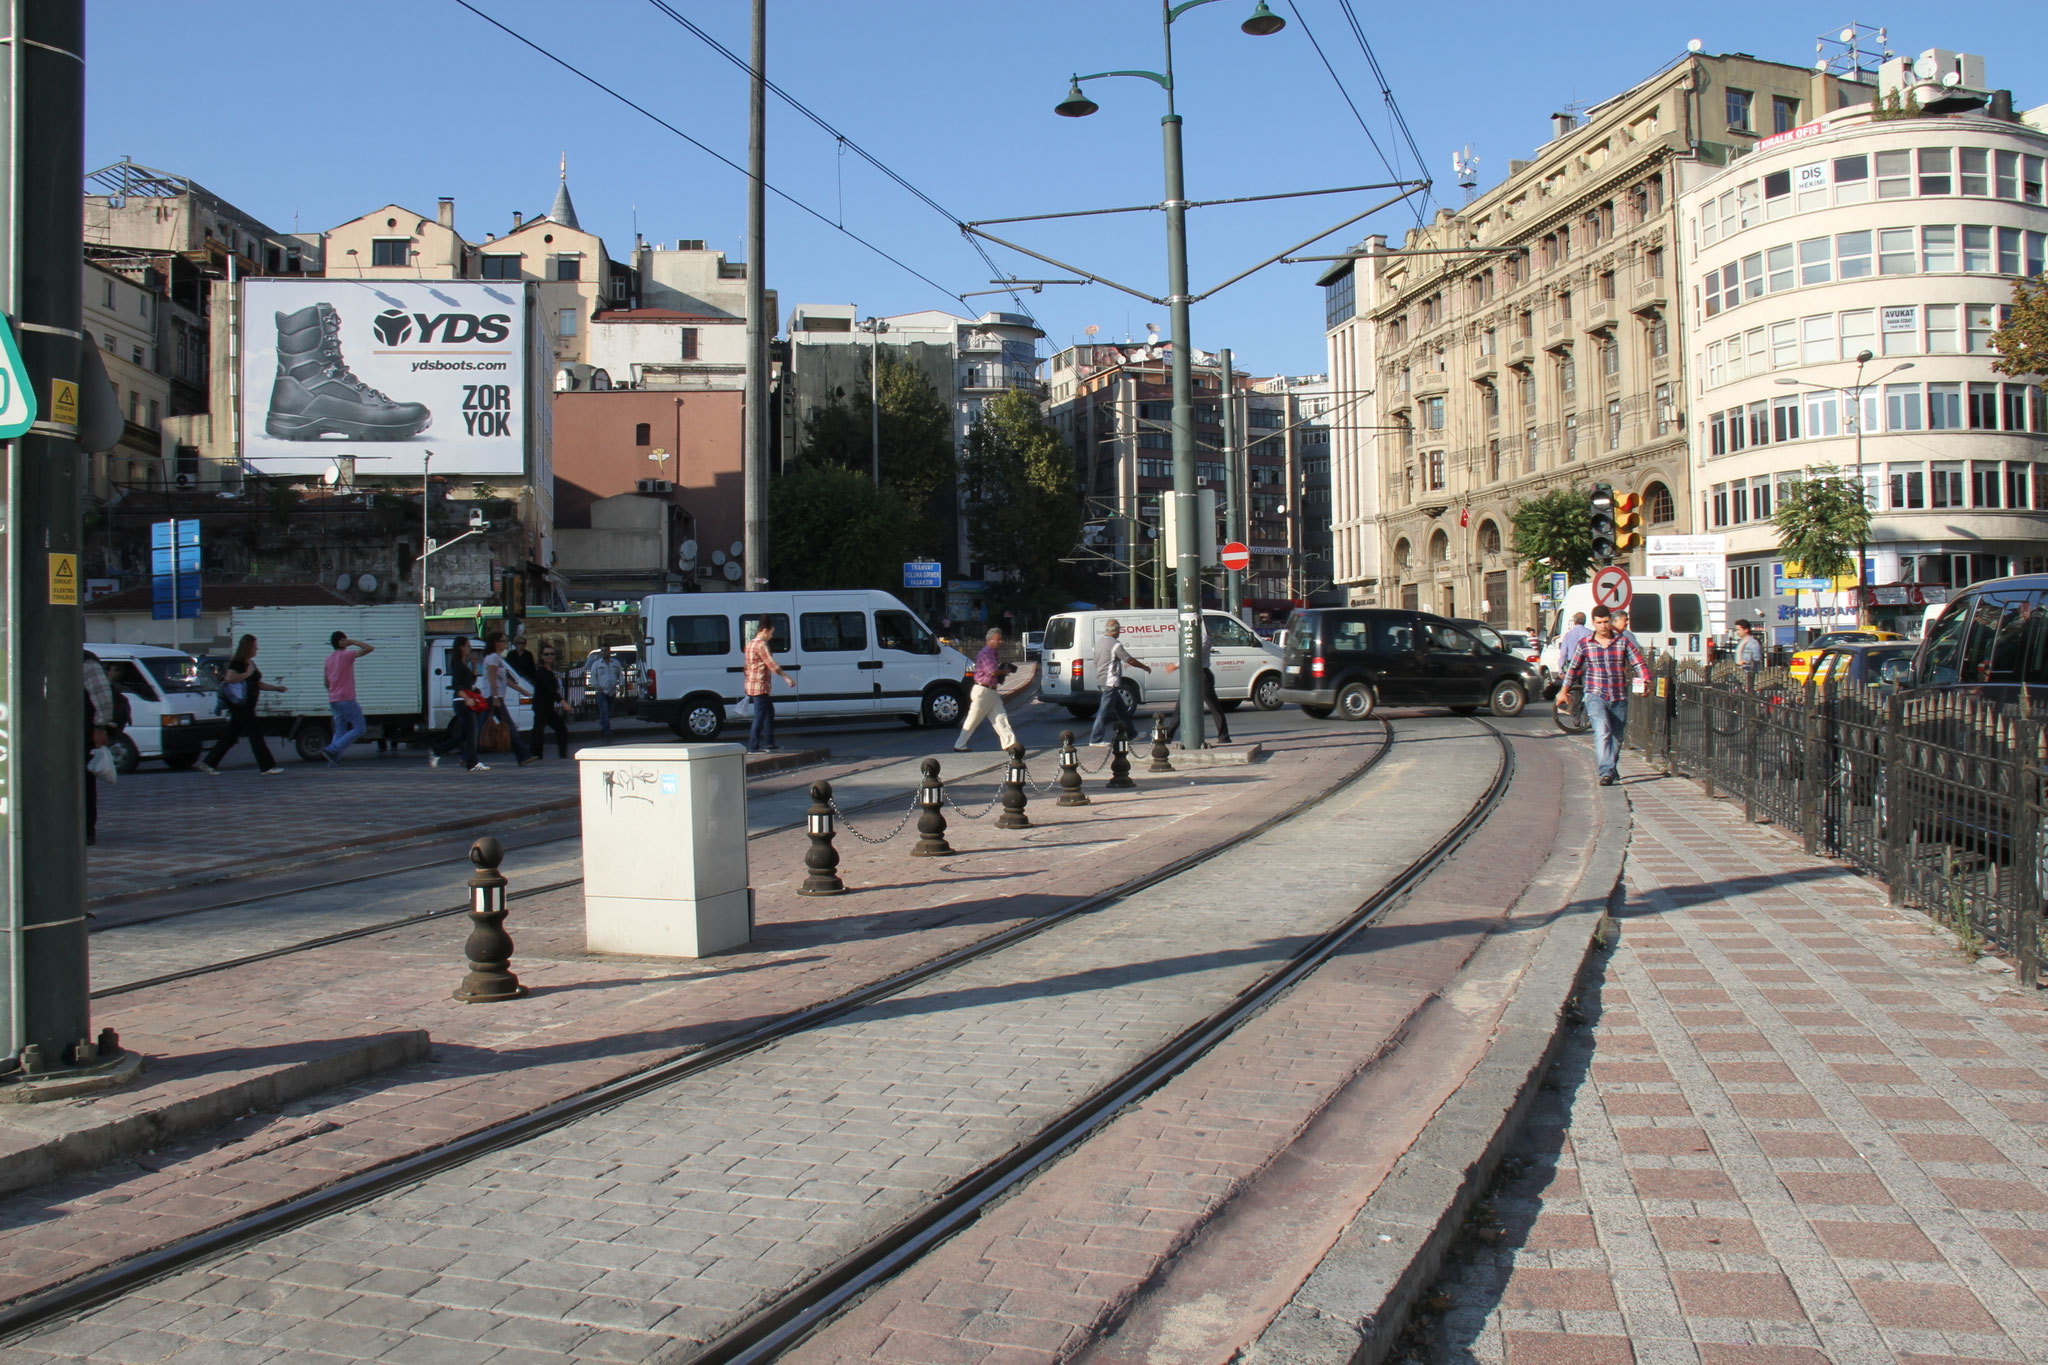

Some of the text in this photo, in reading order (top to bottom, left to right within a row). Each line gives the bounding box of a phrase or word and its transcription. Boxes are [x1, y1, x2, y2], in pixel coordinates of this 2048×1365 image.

[1885, 309, 1914, 318] AVUKAT
[412, 313, 512, 344] YDS
[411, 360, 507, 373] ydsboots.com
[462, 384, 511, 411] ZOR
[462, 411, 511, 437] YOK
[1119, 624, 1176, 634] SOMELPA
